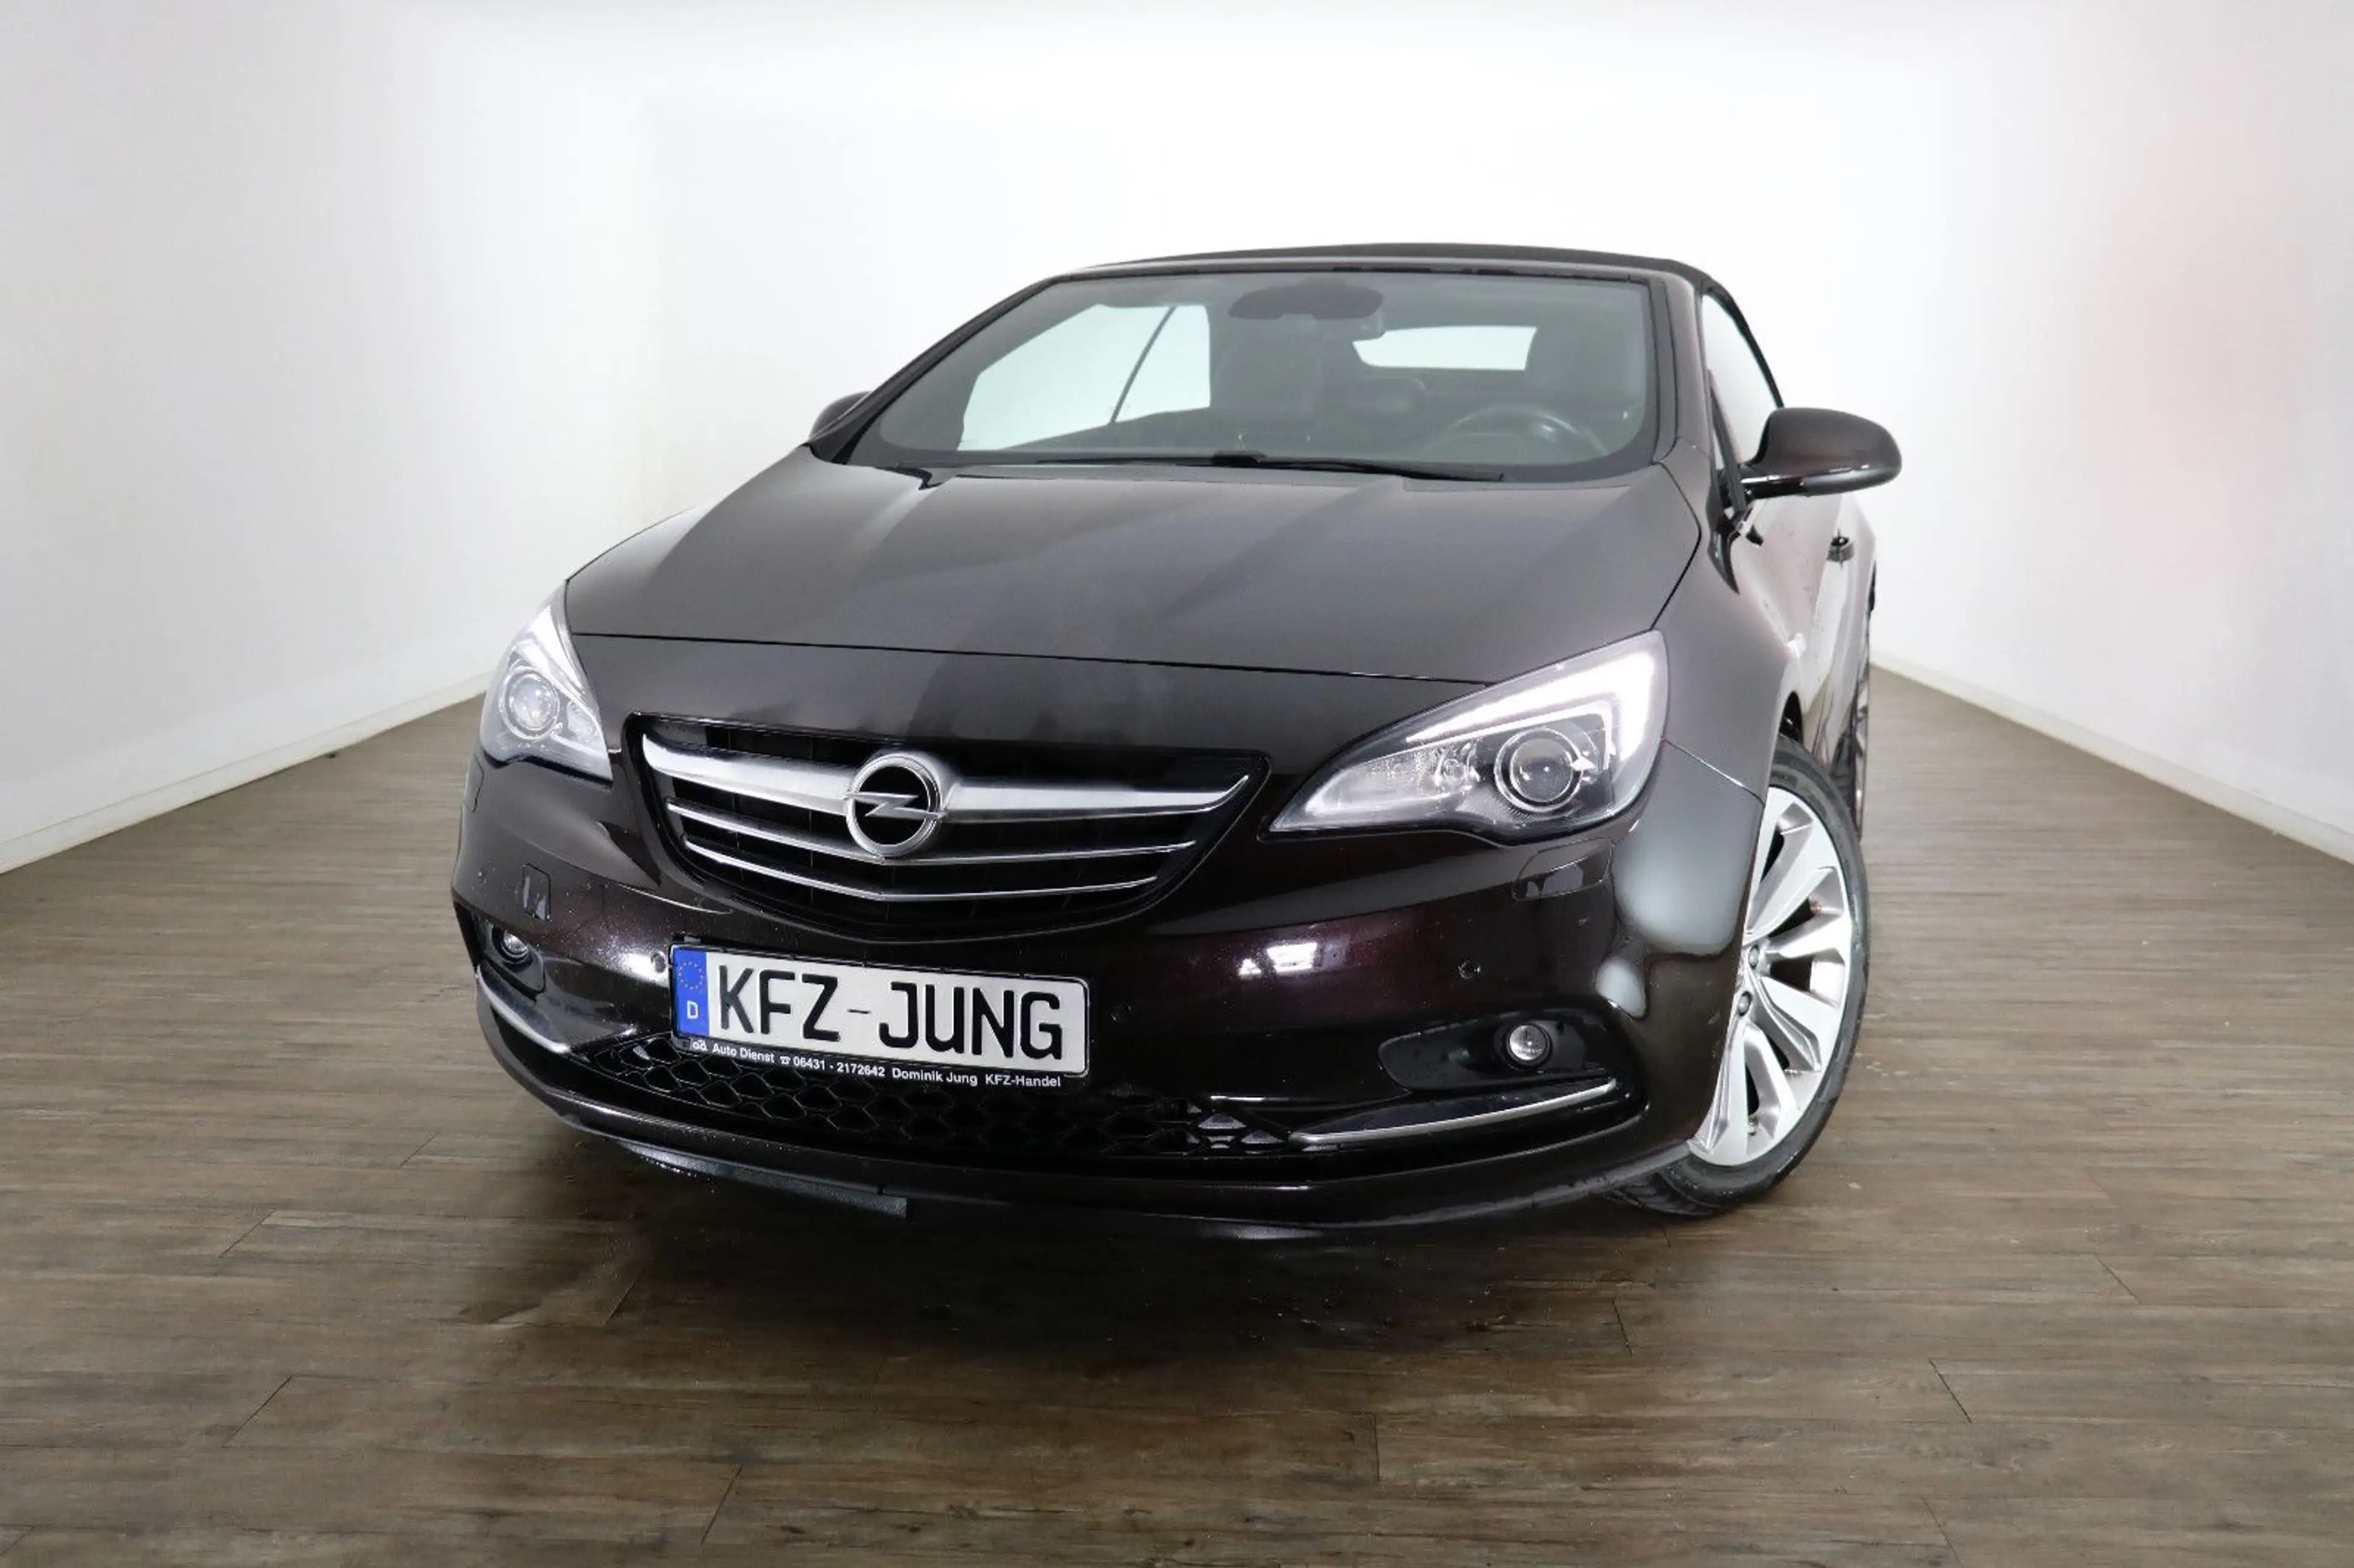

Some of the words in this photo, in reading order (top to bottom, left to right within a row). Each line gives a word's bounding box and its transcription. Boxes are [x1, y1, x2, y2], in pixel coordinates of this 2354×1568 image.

[686, 1001, 699, 1020] D
[712, 1043, 737, 1057] Auto
[740, 1048, 775, 1063] Dienst
[793, 1056, 825, 1070] 06431
[837, 1062, 885, 1077] 2172642
[892, 1067, 943, 1082] Dominik
[947, 1073, 978, 1087] Jung
[985, 1073, 1062, 1087] KFZ-Handel
